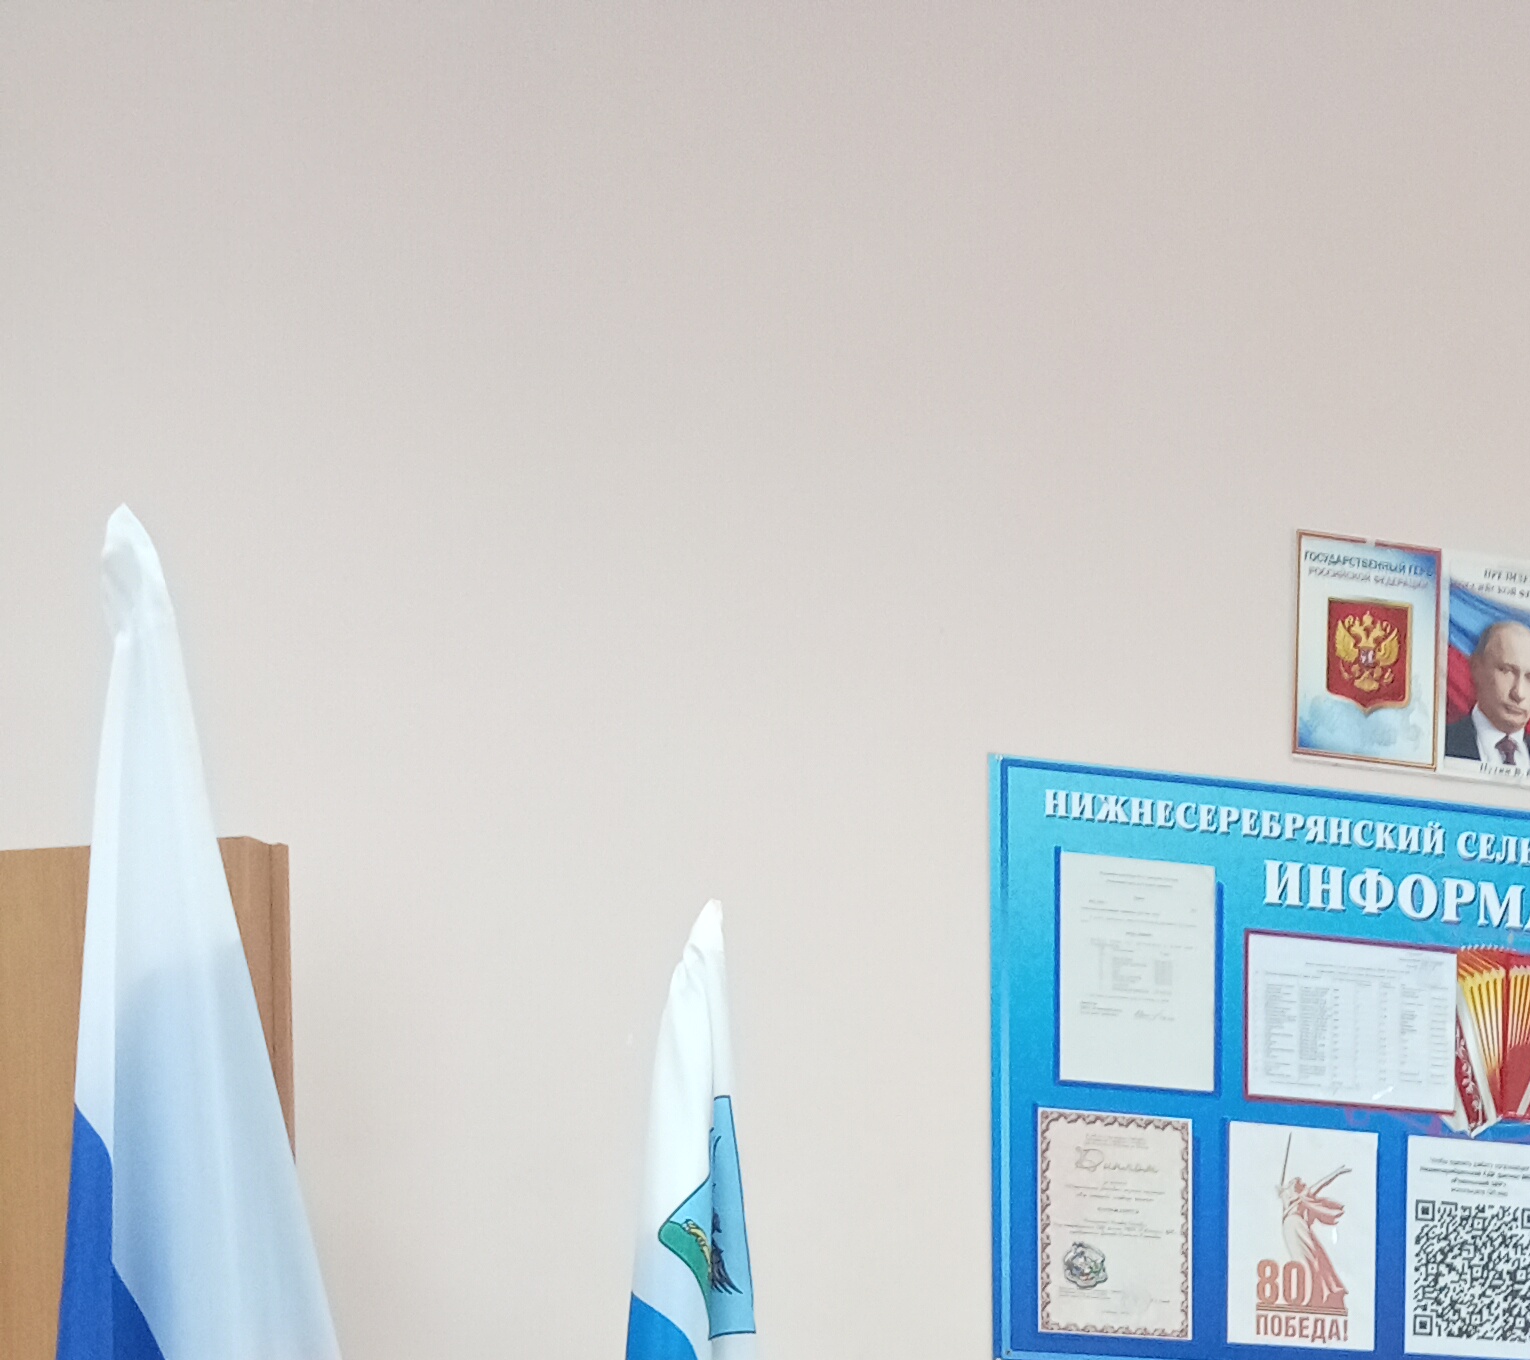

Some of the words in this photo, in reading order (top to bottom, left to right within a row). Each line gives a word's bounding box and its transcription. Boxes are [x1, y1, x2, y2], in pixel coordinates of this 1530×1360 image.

[1045, 789, 1446, 856] НИЖНЕСЕРЕБРЯНСКИЙ
[1256, 1259, 1306, 1305] 80
[1256, 1314, 1348, 1343] ПОБЕДА!
